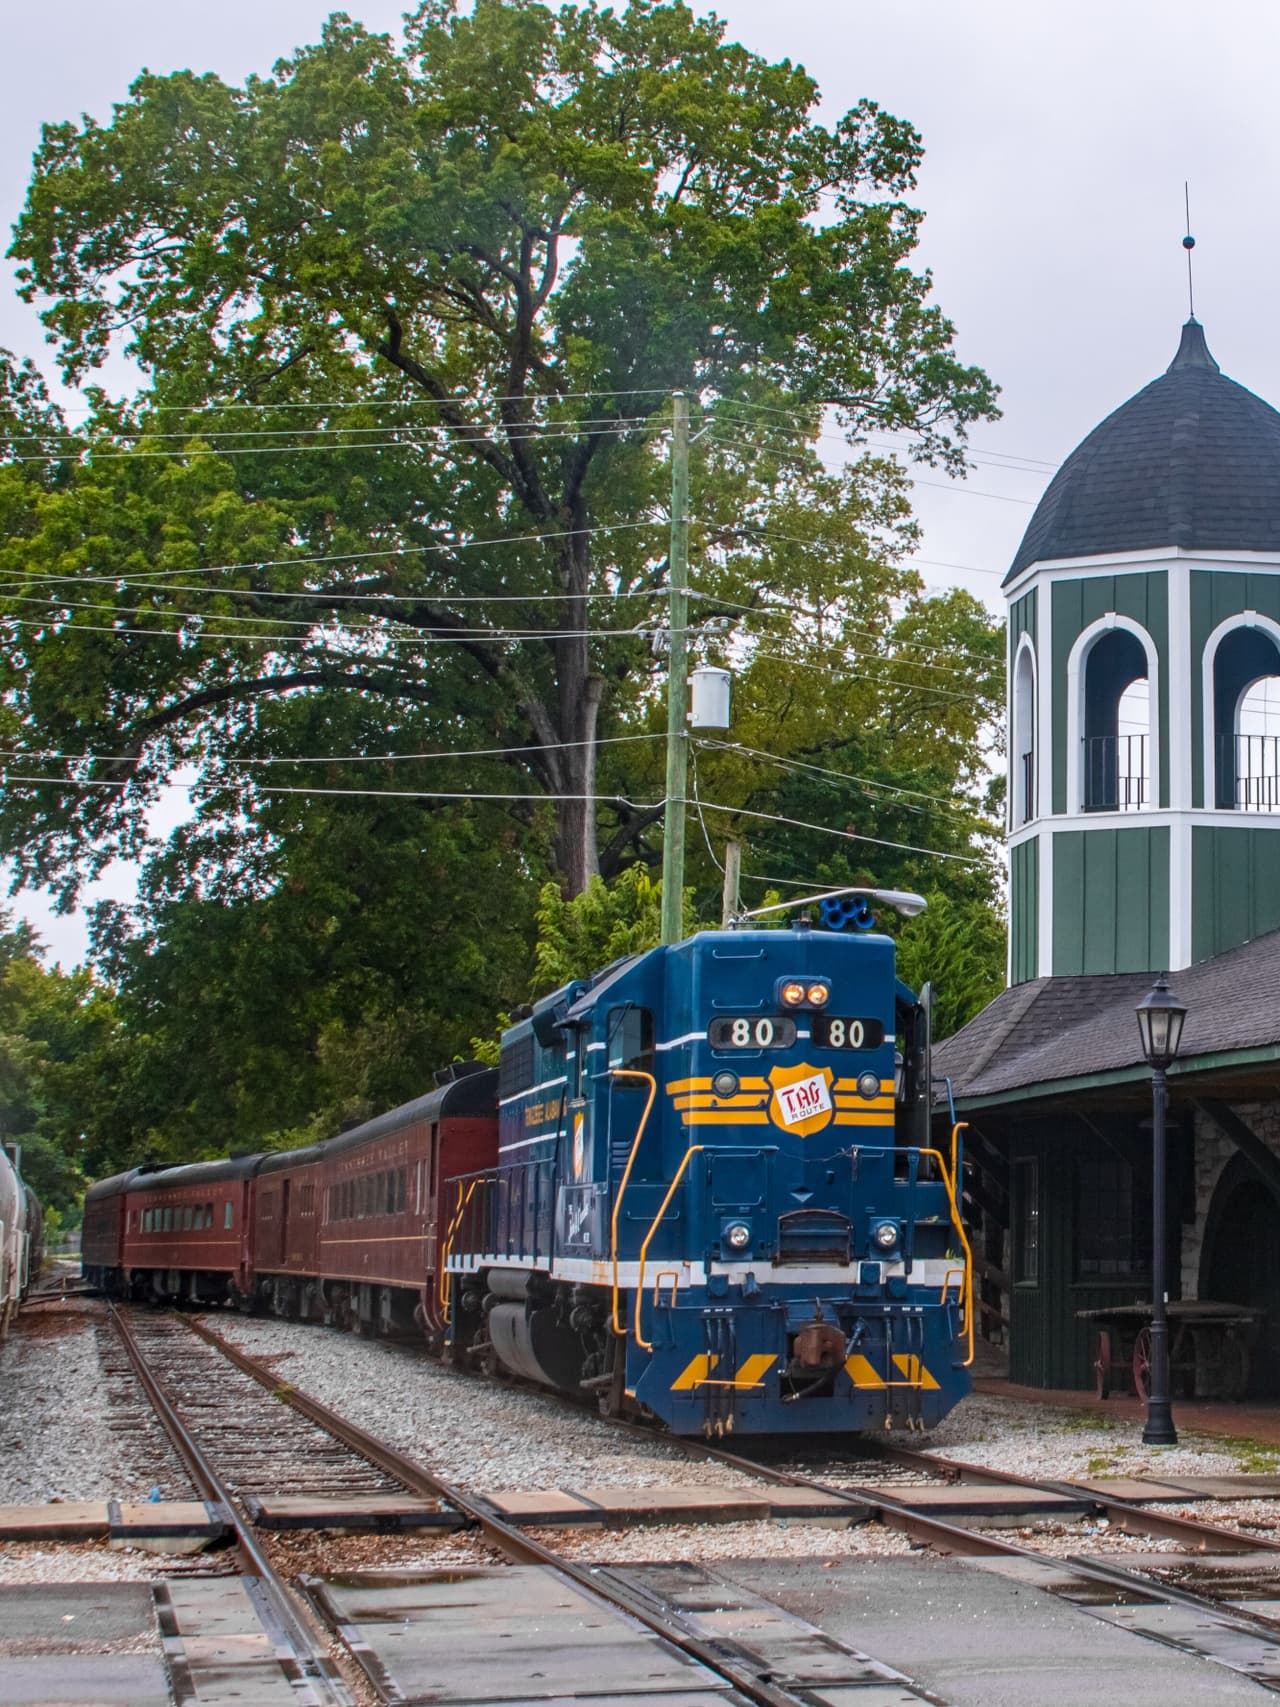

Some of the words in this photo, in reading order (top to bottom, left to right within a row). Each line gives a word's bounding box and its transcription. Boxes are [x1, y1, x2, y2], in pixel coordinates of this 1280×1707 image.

[731, 1018, 773, 1047] 80
[829, 1019, 864, 1048] 80
[782, 1081, 820, 1112] TAG
[791, 1103, 825, 1120] ROUTE
